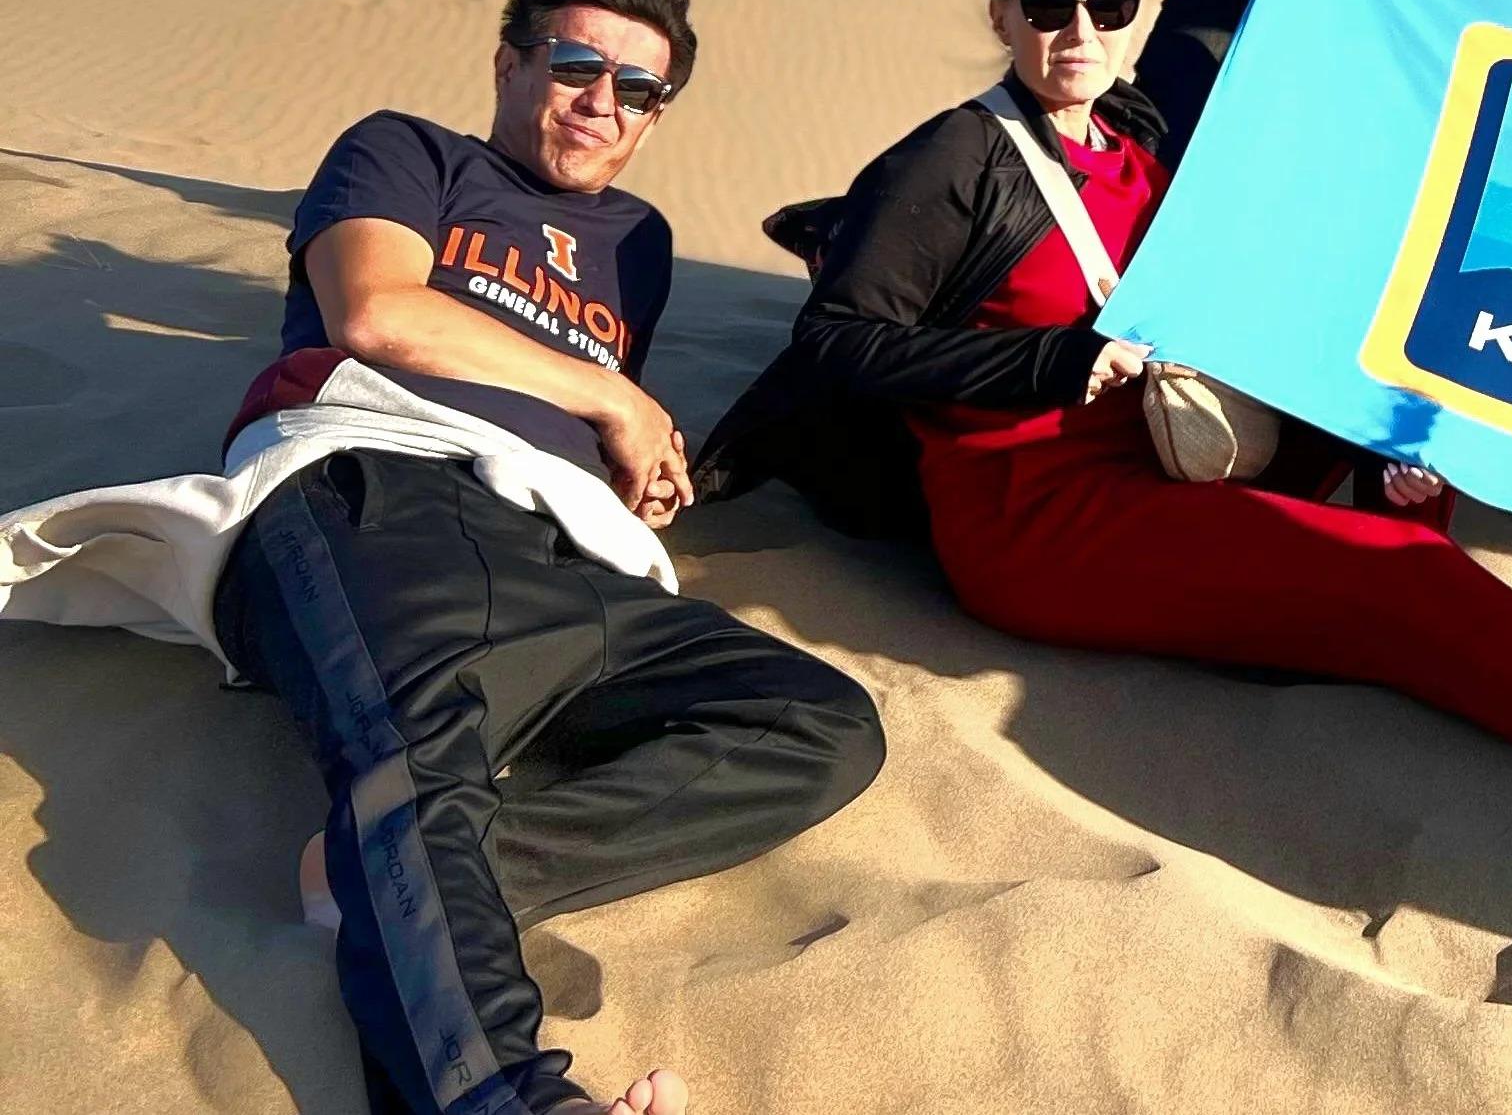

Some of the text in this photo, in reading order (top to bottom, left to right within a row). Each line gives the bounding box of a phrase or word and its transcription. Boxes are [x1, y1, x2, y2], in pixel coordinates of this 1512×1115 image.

[441, 226, 631, 359] ILLINOI
[468, 275, 622, 374] GENERAL STUDI
[381, 823, 417, 920] ORDAN
